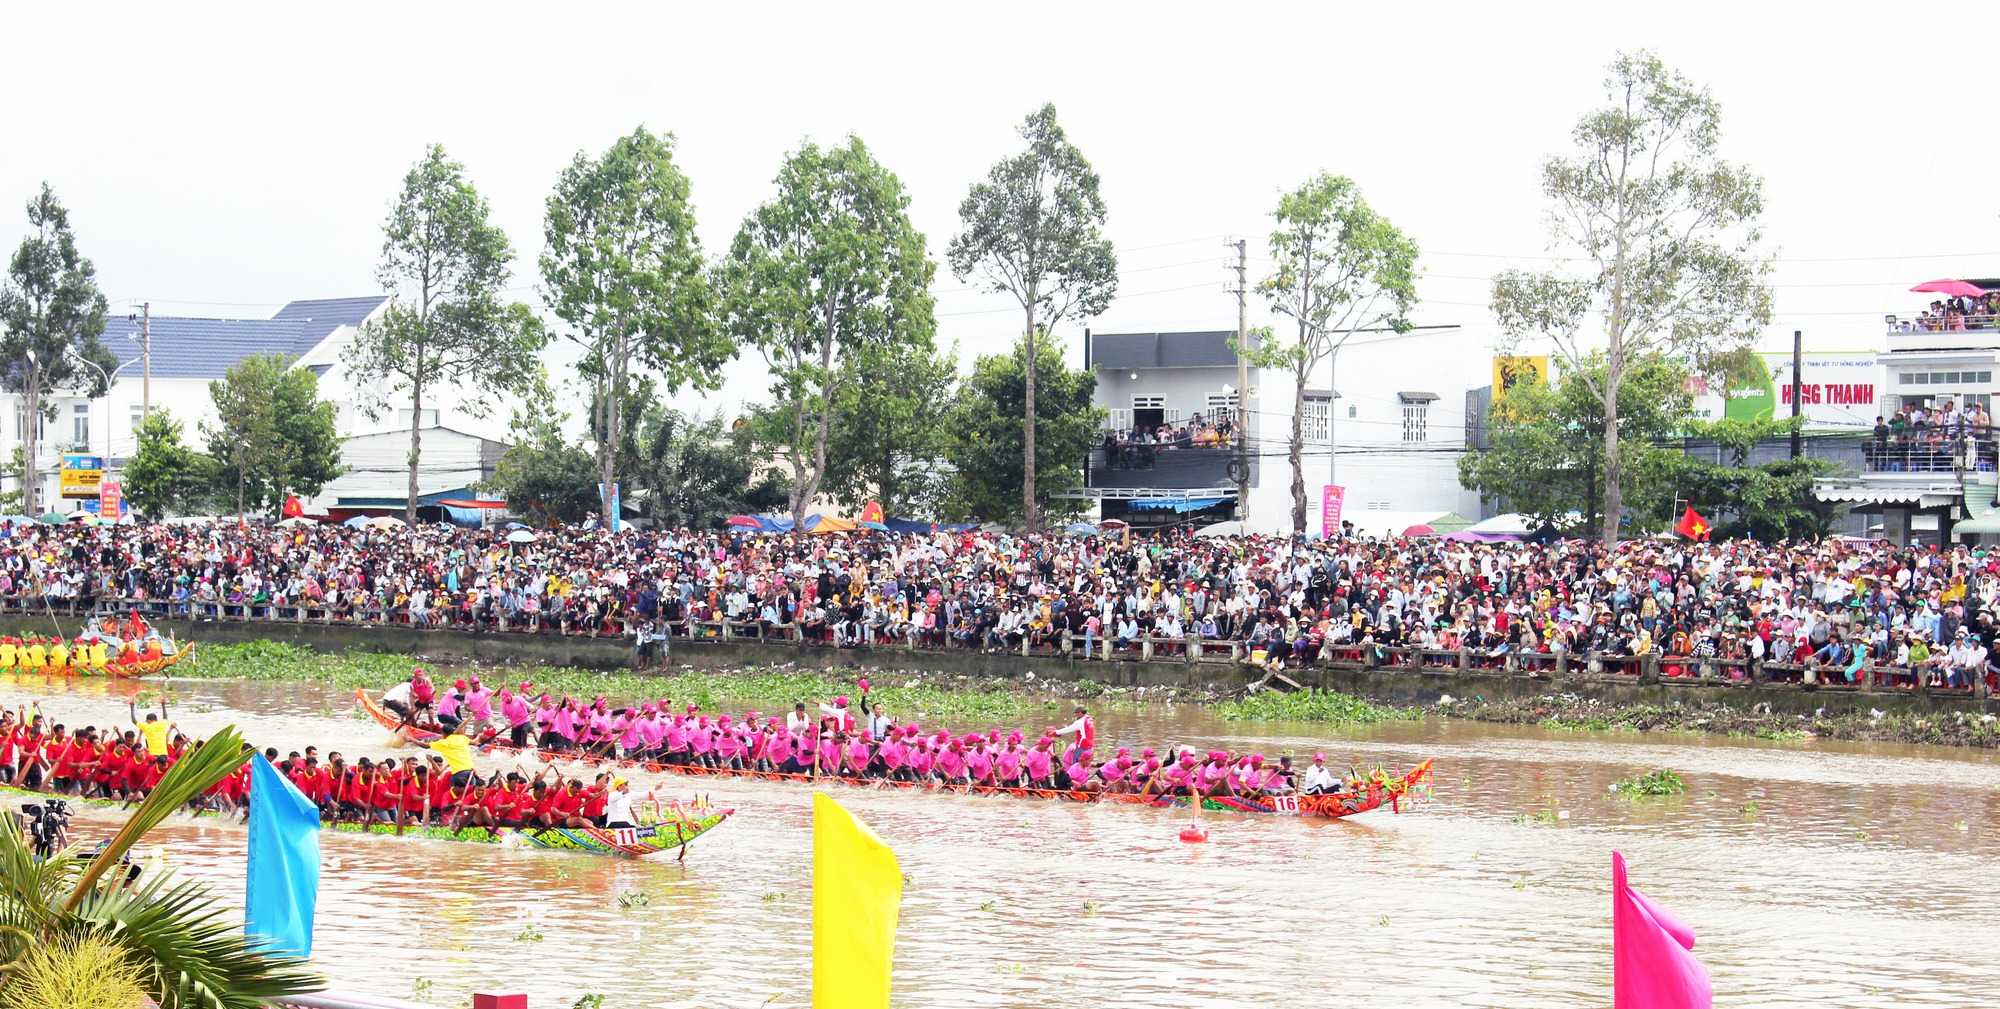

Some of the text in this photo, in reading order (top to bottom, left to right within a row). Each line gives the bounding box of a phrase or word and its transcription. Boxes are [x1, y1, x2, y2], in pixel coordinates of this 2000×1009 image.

[1825, 384, 1873, 409] THẠNH
[1278, 797, 1295, 810] 16
[619, 829, 635, 844] 11
